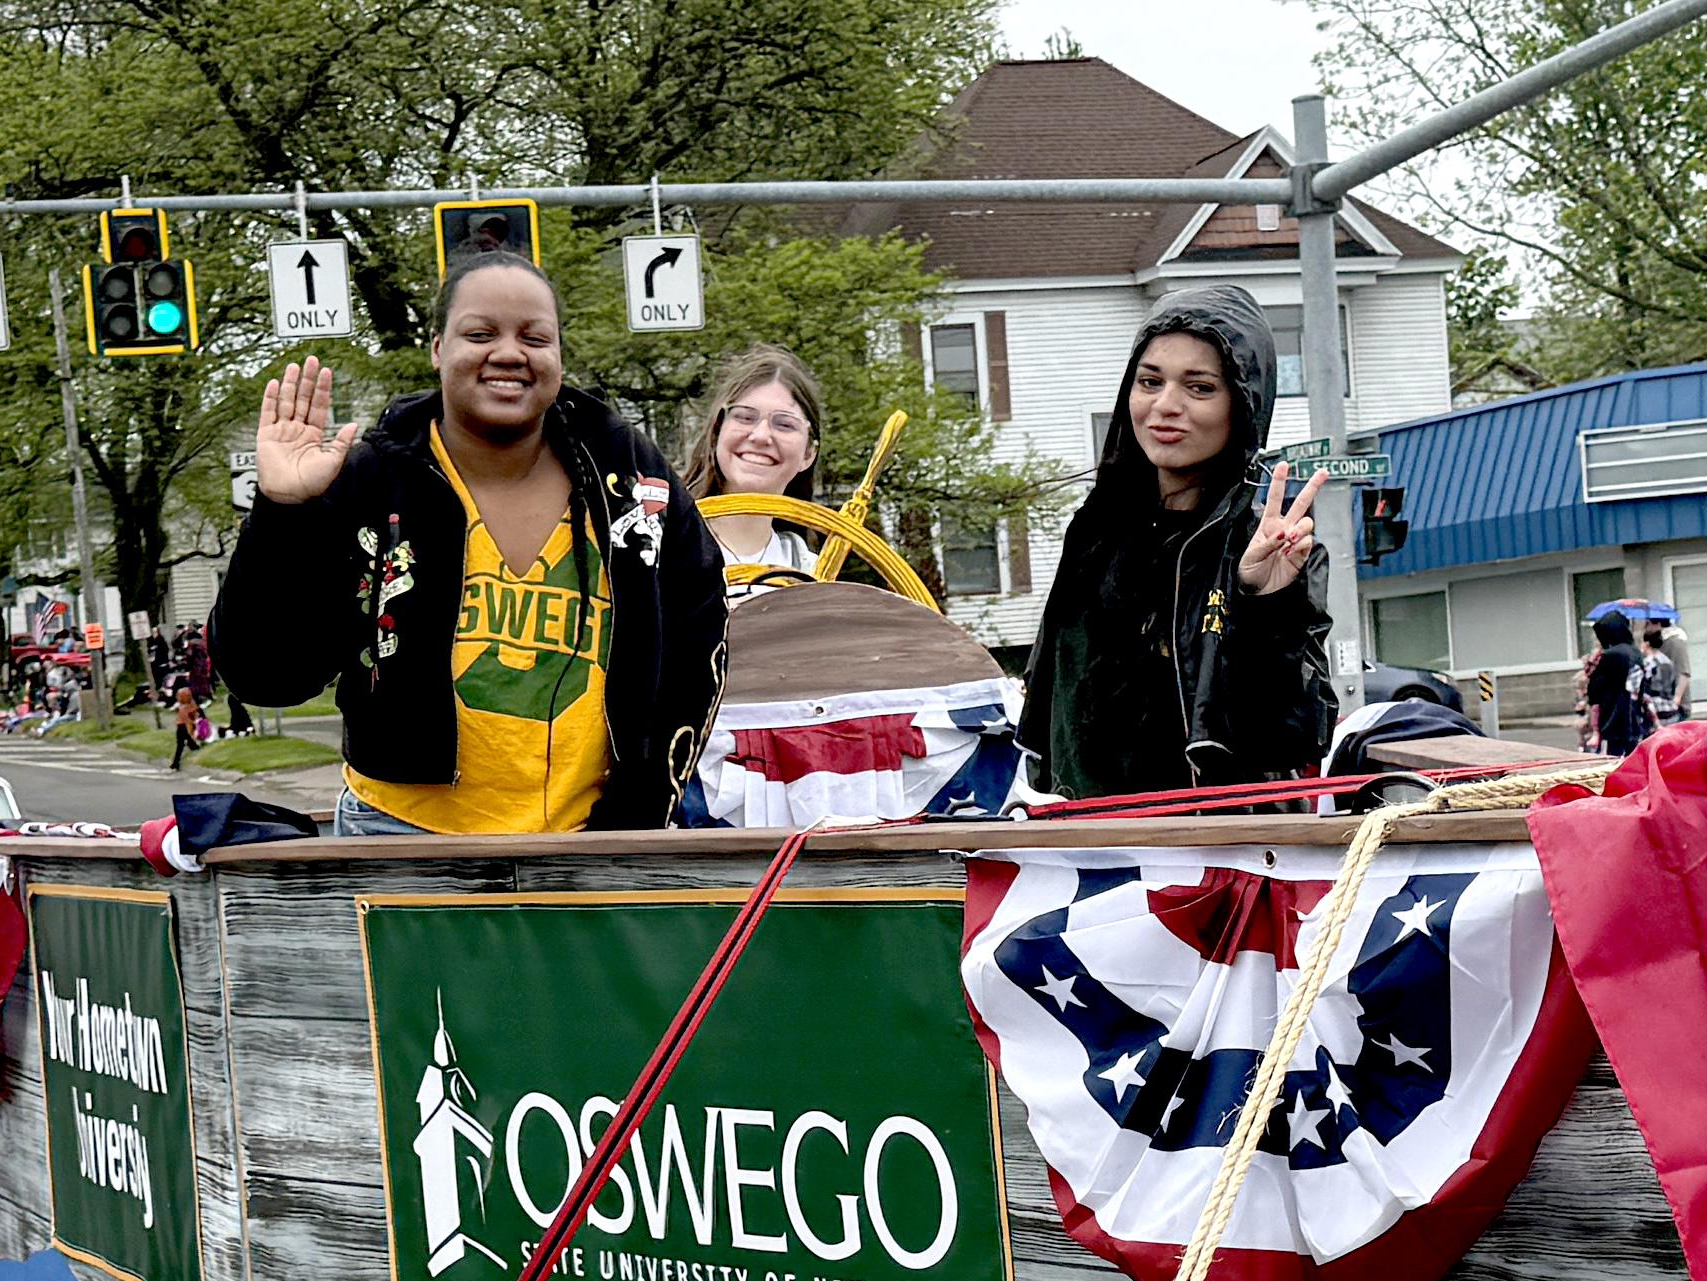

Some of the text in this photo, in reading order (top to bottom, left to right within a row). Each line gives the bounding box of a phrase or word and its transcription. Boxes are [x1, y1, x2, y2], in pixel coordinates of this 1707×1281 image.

[287, 309, 337, 329] ONLY
[641, 303, 690, 322] ONLY
[458, 580, 613, 673] SWEG
[505, 1091, 960, 1270] OSWEGO
[521, 1241, 585, 1277] STE
